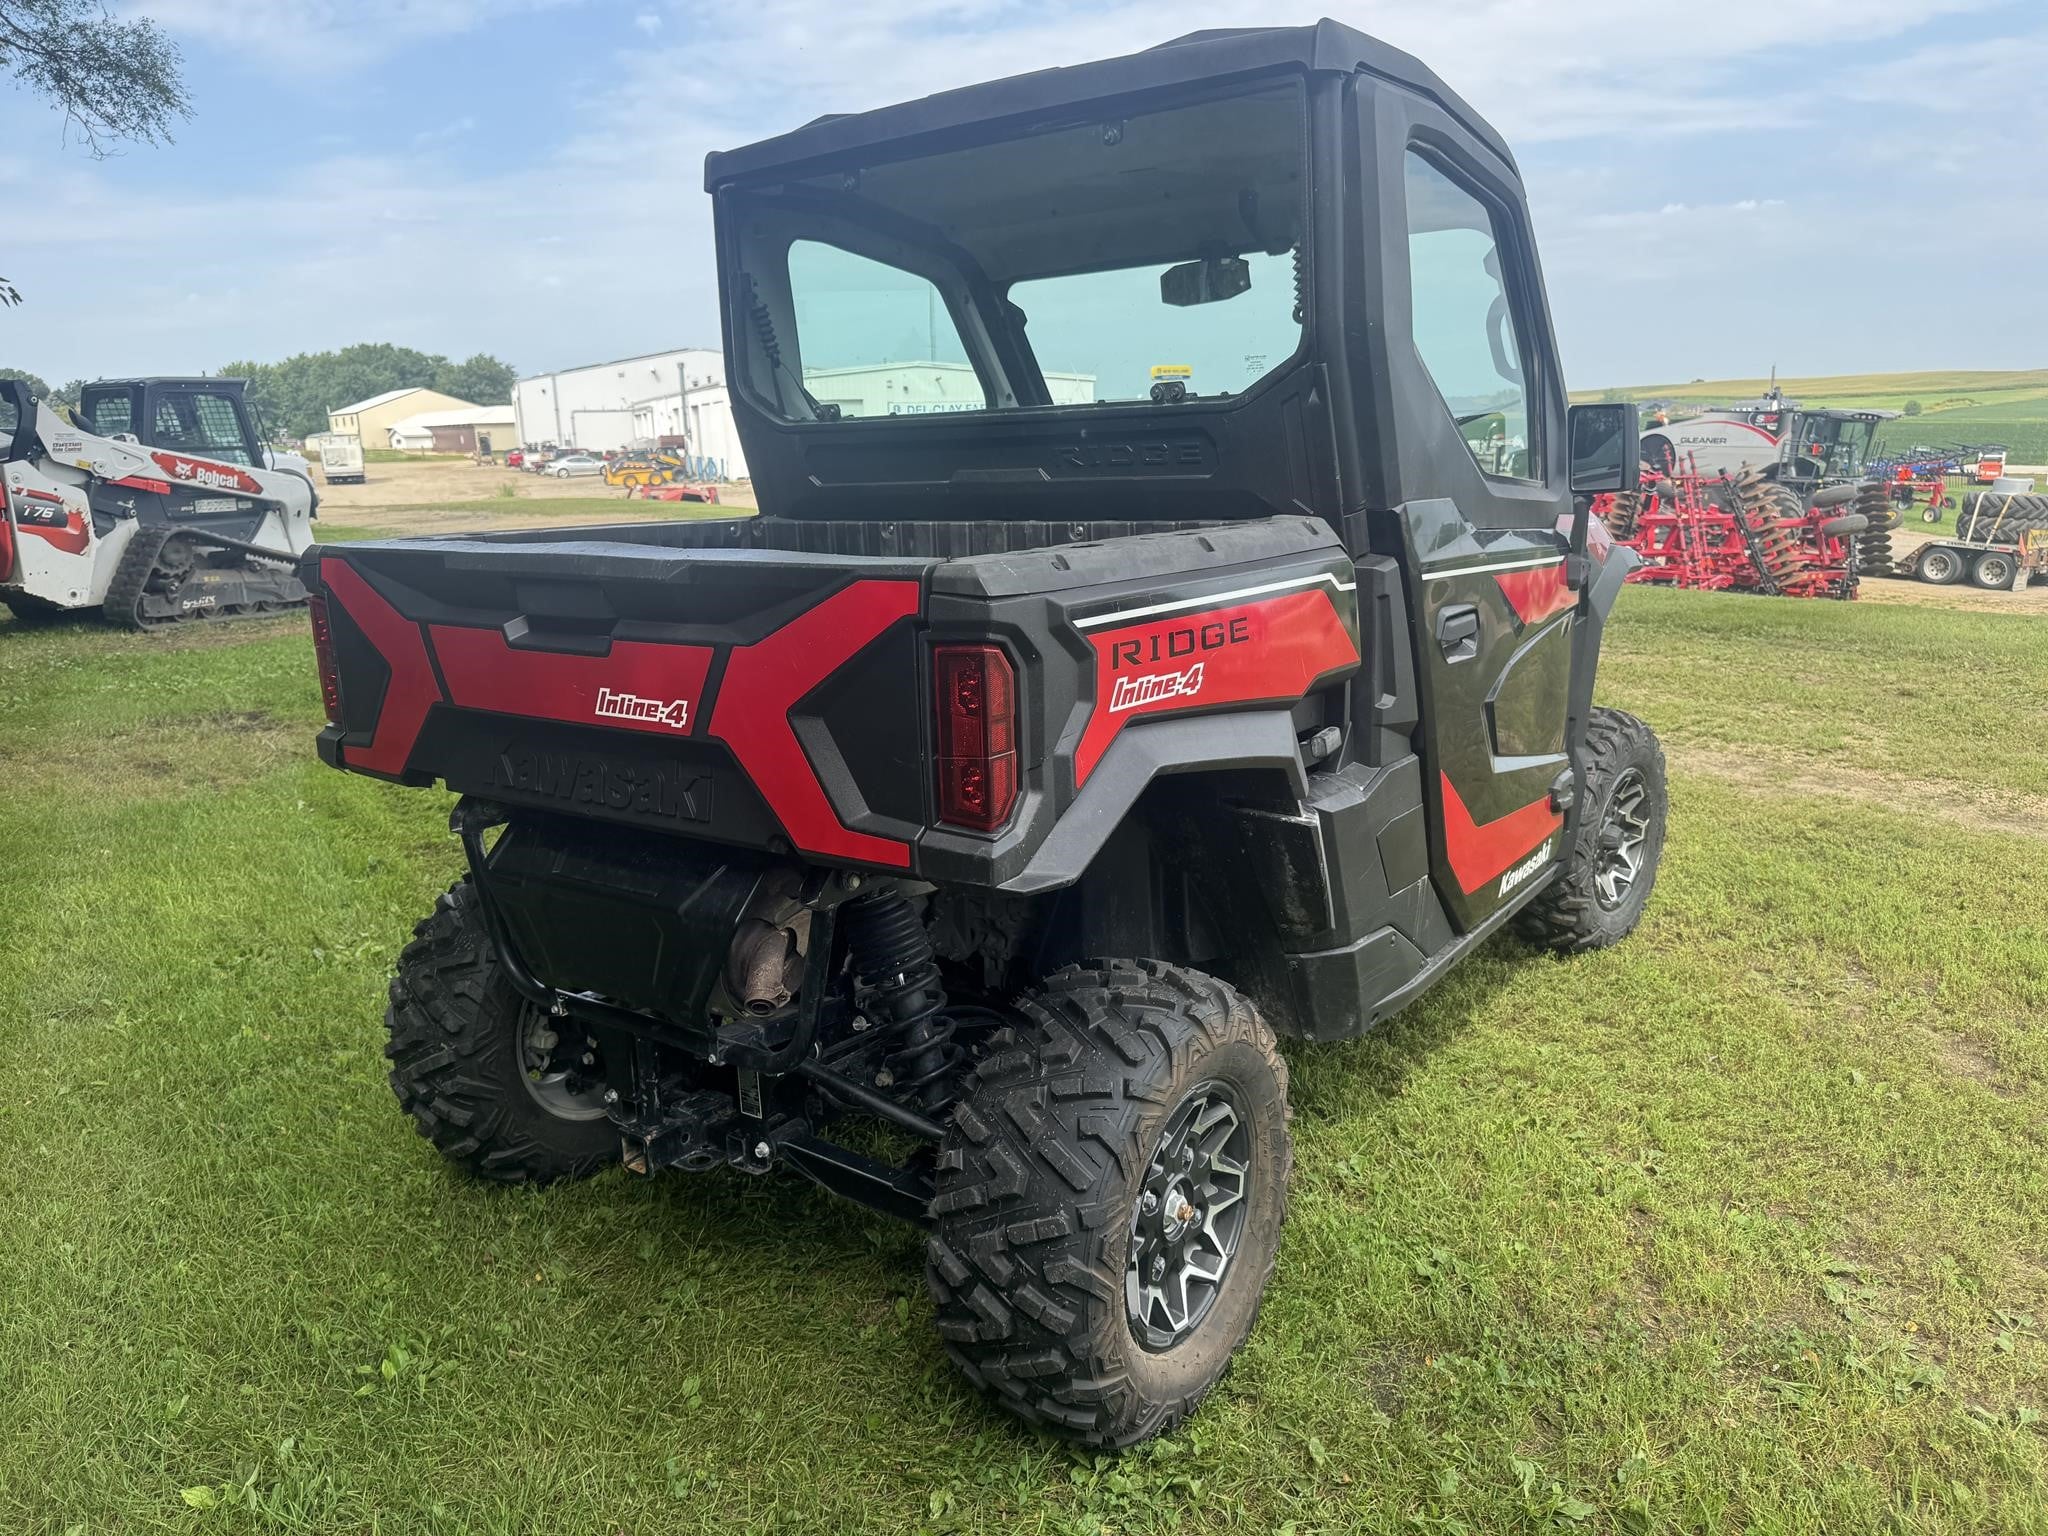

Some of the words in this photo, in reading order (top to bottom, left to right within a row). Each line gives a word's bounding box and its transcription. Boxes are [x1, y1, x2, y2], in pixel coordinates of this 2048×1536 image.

[1681, 437, 1727, 445] GLEANER
[196, 467, 238, 489] Bobcat
[23, 505, 55, 518] T76
[1112, 617, 1250, 670] RIDGE
[595, 688, 688, 728] Inline-4
[1109, 662, 1205, 713] Inline-4
[484, 744, 714, 823] Kawasaki
[1498, 838, 1552, 898] Kawasaki
